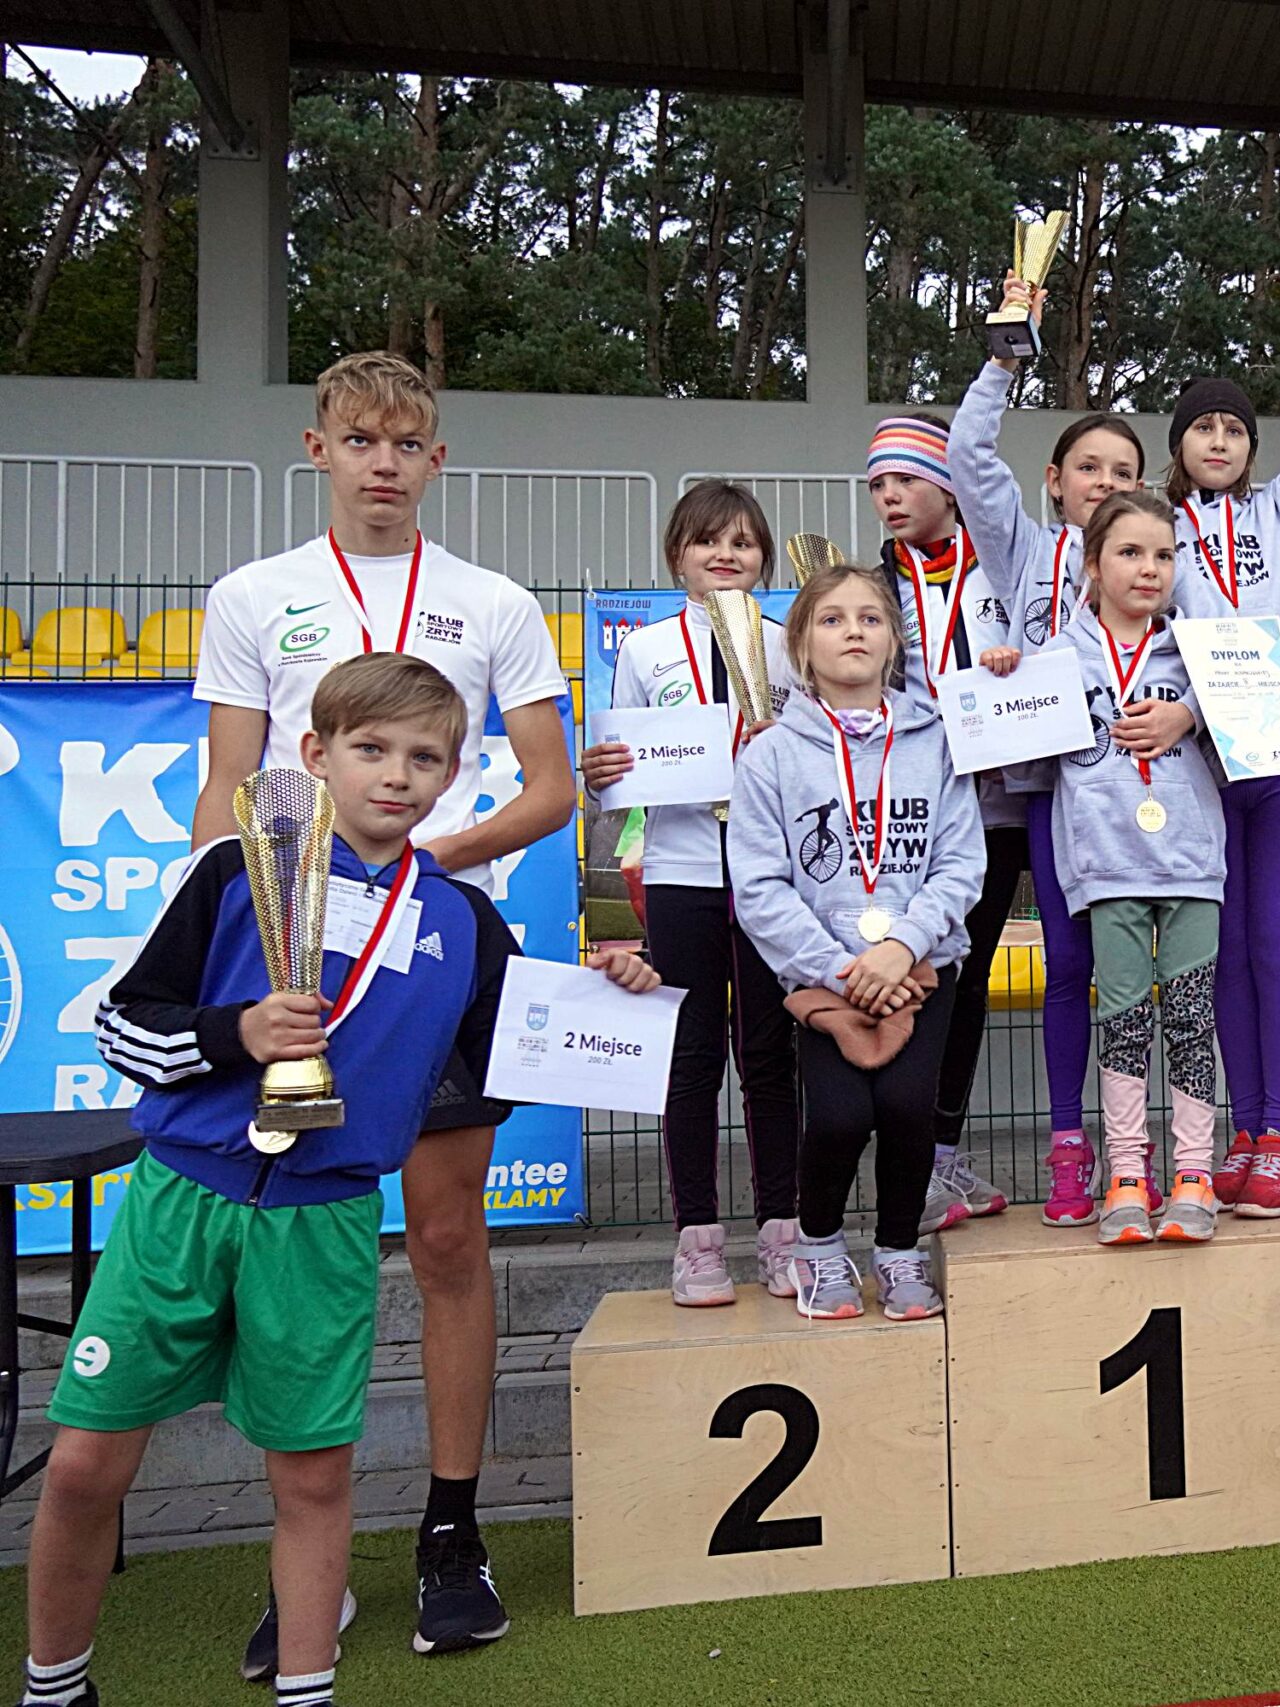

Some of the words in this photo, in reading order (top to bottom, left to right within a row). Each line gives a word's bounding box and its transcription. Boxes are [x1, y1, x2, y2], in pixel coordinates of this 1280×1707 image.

[427, 614, 464, 628] KLUB
[291, 634, 317, 643] SGB
[426, 627, 463, 640] ZRYW
[1211, 651, 1260, 661] DYPLOM
[663, 690, 683, 701] SGB
[993, 703, 1003, 716] 3
[1006, 694, 1059, 714] Miejsce
[638, 748, 648, 760] 2
[651, 744, 706, 760] Miejsce
[563, 1032, 576, 1050] 2
[579, 1033, 643, 1058] Miejsce
[587, 1056, 602, 1065] 200
[487, 1160, 568, 1187] ntee
[1099, 1307, 1187, 1500] 1
[708, 1383, 823, 1556] 2
